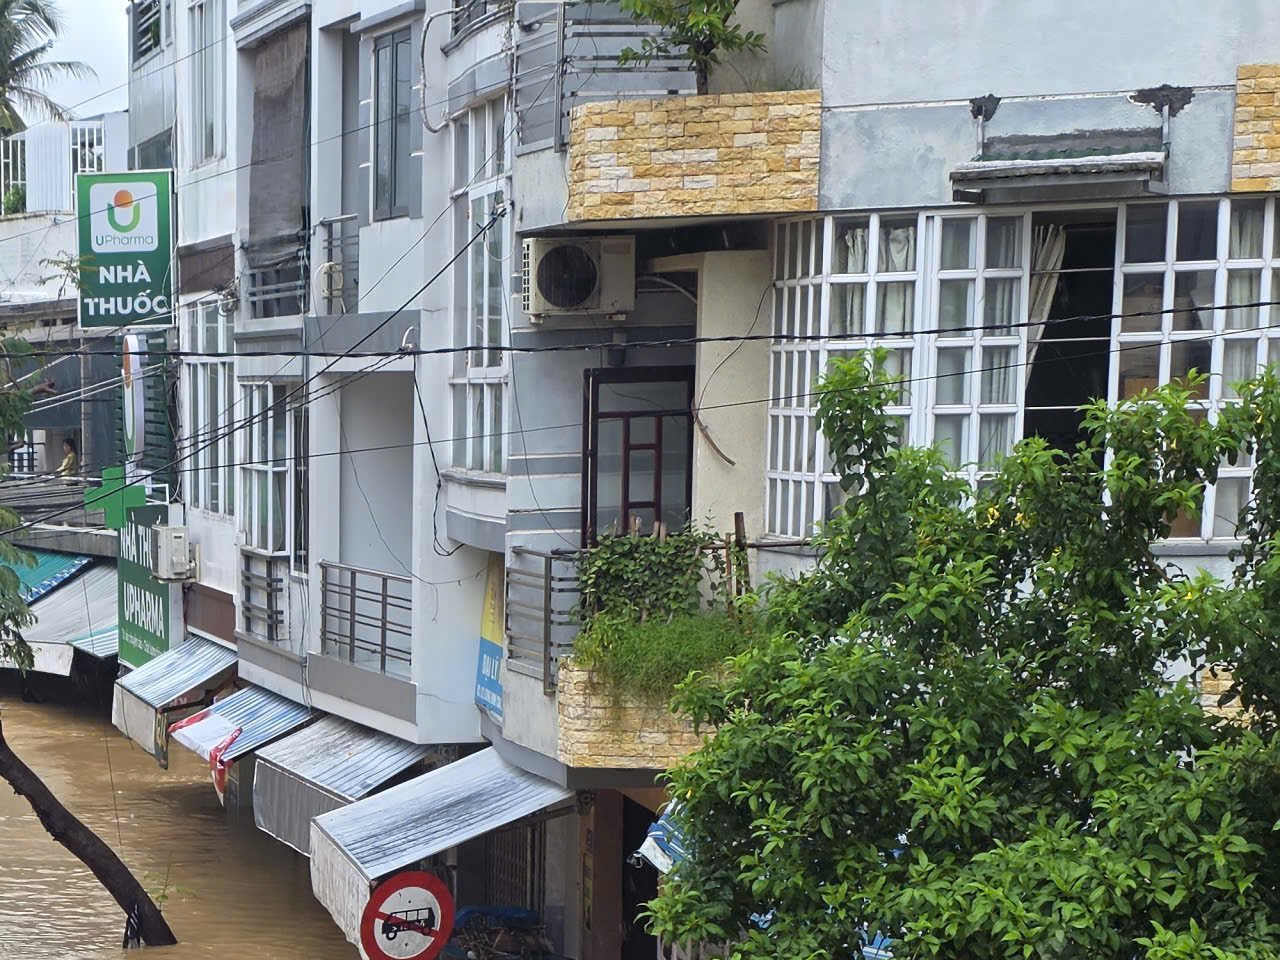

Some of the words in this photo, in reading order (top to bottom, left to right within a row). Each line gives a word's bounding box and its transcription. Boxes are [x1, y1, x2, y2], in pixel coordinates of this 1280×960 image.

[95, 234, 154, 247] UPharma
[99, 259, 152, 285] NHÀ
[83, 290, 169, 316] THUỐC
[120, 511, 138, 564] NHÀ
[123, 581, 165, 640] UPHARMA
